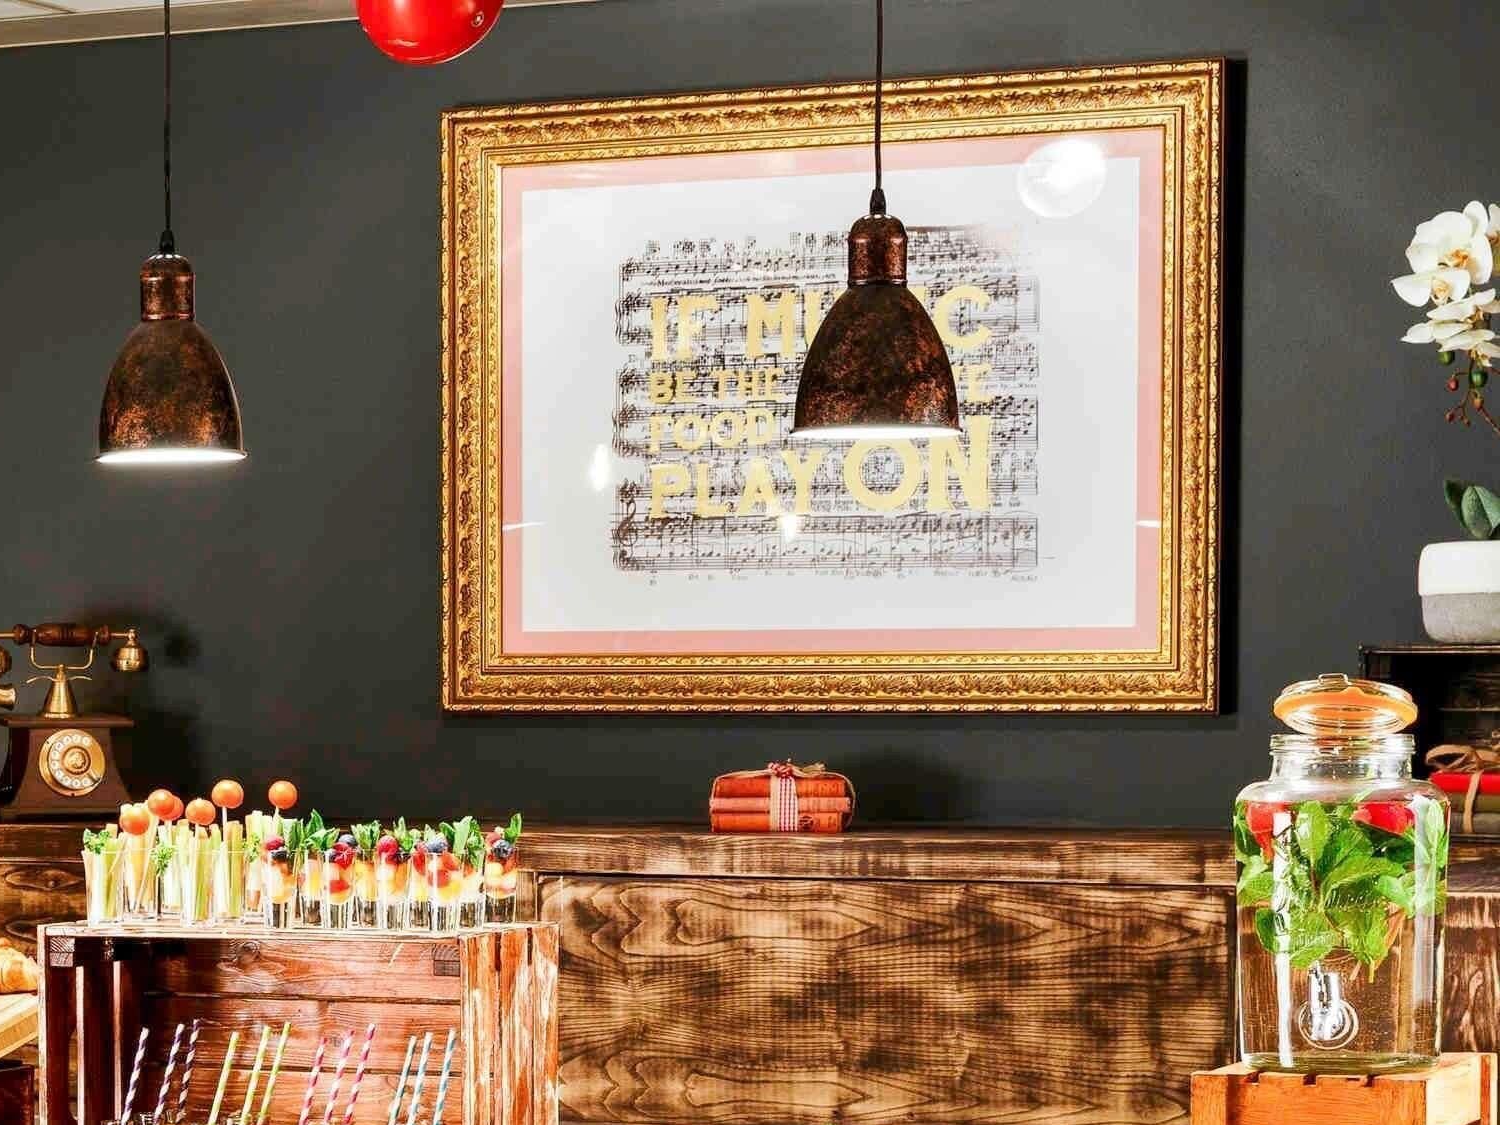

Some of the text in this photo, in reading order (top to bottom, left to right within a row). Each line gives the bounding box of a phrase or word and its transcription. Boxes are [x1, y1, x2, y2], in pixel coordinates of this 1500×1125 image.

[650, 293, 720, 362] IF
[649, 365, 785, 403] BE THE
[649, 407, 775, 454] FOOD
[649, 414, 993, 518] PLAY ON
